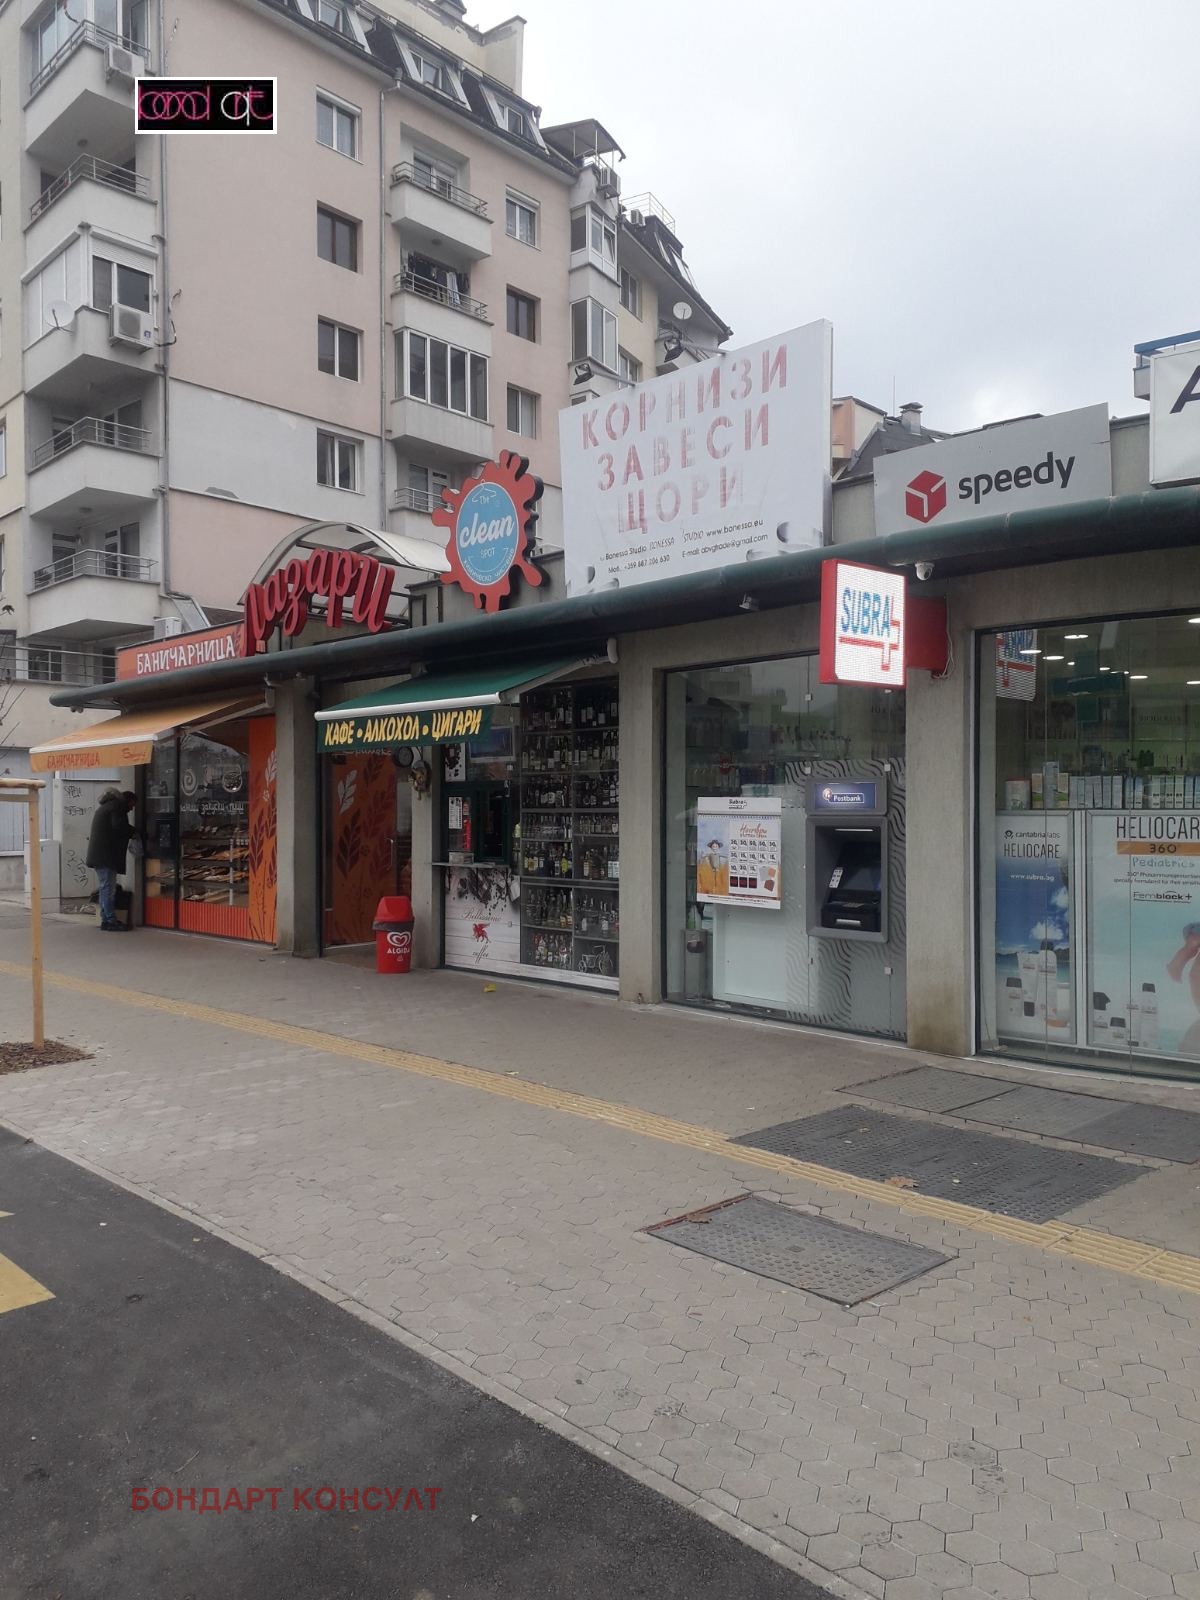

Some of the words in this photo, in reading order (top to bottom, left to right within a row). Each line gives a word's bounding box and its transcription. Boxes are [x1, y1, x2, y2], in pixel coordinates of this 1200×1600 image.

[582, 344, 788, 449] КОРНИЗИ
[597, 403, 769, 491] ЗАВЕСИ
[958, 451, 1076, 504] speedy
[618, 465, 743, 534] ЩОРИ
[460, 512, 515, 548] clean
[841, 586, 891, 638] SUBRA
[136, 634, 236, 675] БАНИЧАРНИЦА
[324, 720, 355, 746] КАФЕ
[363, 715, 420, 743] АЛКОХОЛ
[431, 709, 482, 742] ЦИГАРИ
[1003, 842, 1061, 859] HELIOCARE
[1132, 856, 1195, 868] Pediatrics
[1149, 843, 1177, 854] 360
